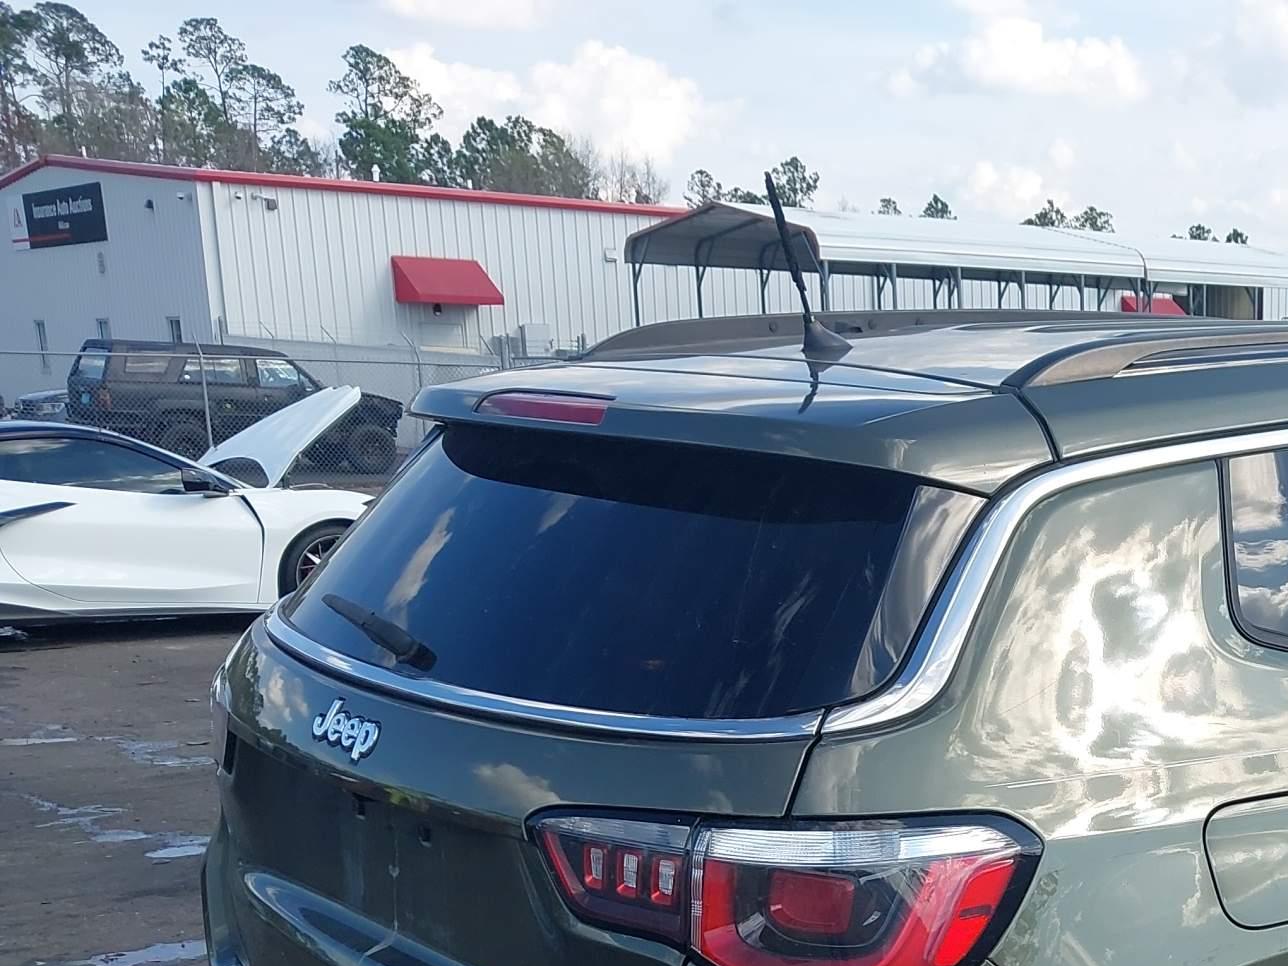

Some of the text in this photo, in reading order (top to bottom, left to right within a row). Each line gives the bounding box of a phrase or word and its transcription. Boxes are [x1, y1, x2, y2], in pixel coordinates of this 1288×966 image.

[32, 203, 57, 219] Insurance
[56, 198, 69, 216] Auto
[69, 195, 93, 215] Auctions
[312, 697, 381, 764] Jeep
